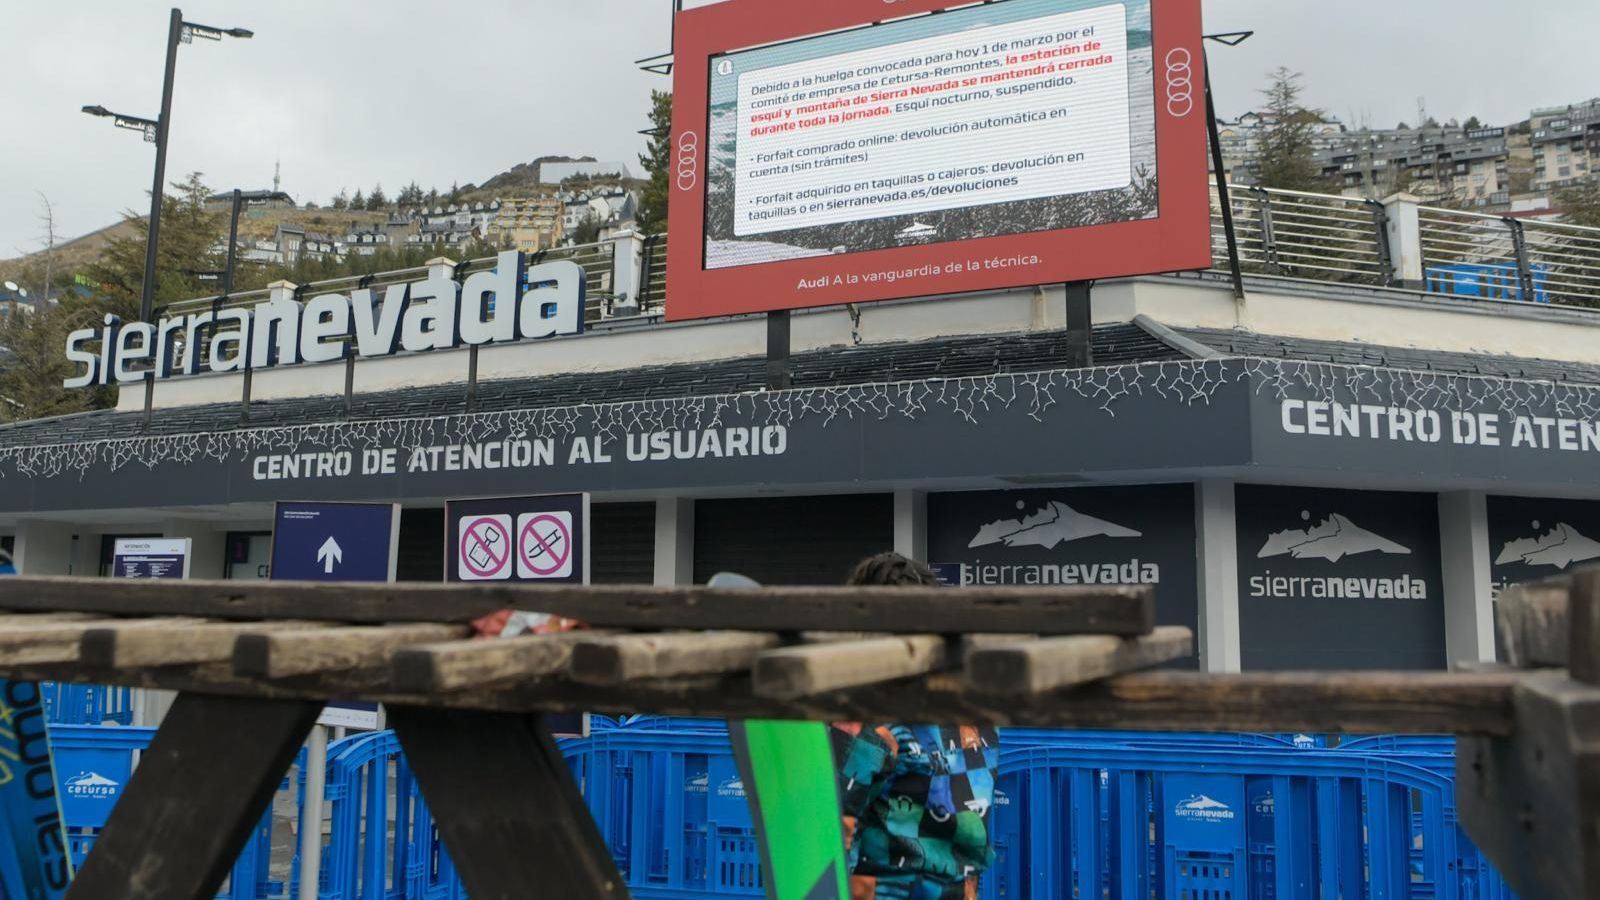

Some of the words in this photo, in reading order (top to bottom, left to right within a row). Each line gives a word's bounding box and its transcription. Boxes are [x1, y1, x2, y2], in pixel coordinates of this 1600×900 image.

[751, 81, 790, 96] Debido
[793, 80, 800, 89] a
[802, 76, 812, 86] la
[815, 69, 854, 85] huelga
[857, 57, 922, 76] convocada
[925, 53, 953, 68] para
[956, 46, 980, 60] hoy
[982, 44, 988, 55] 1
[992, 41, 1008, 53] de
[1011, 35, 1053, 50] marzo
[1056, 30, 1079, 45] por
[1082, 25, 1094, 37] el
[751, 93, 789, 109] comité
[792, 89, 806, 102] de
[808, 83, 861, 100] empresa
[863, 78, 879, 90] de
[881, 60, 1003, 86] Cetursa-Remontes,
[1006, 54, 1018, 65] la
[1021, 43, 1081, 62] estación
[1083, 40, 1101, 52] de
[784, 108, 792, 119] y
[796, 97, 850, 115] montaña
[853, 95, 869, 106] de
[871, 89, 908, 102] Sierra
[911, 80, 959, 95] Nevada
[962, 77, 977, 87] se
[980, 64, 1055, 84] mantendrá
[1058, 53, 1113, 72] cerrada
[750, 121, 796, 137] durante
[799, 116, 826, 128] toda
[829, 113, 840, 123] la
[841, 105, 892, 123] jornada.
[932, 88, 993, 107] nocturno,
[996, 76, 1077, 97] suspendido.
[756, 149, 794, 164] Forfait
[796, 140, 856, 158] comprado
[858, 134, 898, 147] online:
[901, 122, 968, 141] devolución
[971, 109, 1047, 130] automática
[1050, 107, 1067, 119] en
[749, 163, 789, 179] cuenta
[791, 160, 812, 174] (sin
[814, 152, 869, 169] trámites)
[756, 192, 793, 206] Forfait
[796, 183, 851, 200] adquirido
[854, 182, 869, 191] en
[872, 174, 924, 189] taquillas
[927, 172, 935, 181] o
[938, 165, 989, 181] cajeros:
[992, 154, 1064, 172] devolución
[1067, 151, 1084, 162] en
[749, 206, 797, 221] taquillas
[799, 204, 807, 214] o
[809, 202, 824, 212] en
[827, 176, 1018, 210] sierranevada.es/devoluciones
[797, 275, 829, 290] Audi
[833, 275, 843, 286] A
[846, 272, 859, 284] la
[862, 264, 941, 284] vanguardia
[945, 261, 963, 273] de
[967, 259, 980, 271] la
[983, 253, 1043, 270] técnica.
[63, 250, 584, 388] sierranevada
[252, 449, 353, 481] CENTRO
[362, 447, 397, 476] DE
[408, 432, 555, 473] ATENCIÓN
[568, 436, 613, 465] AL
[626, 424, 788, 462] USUARIO
[1281, 399, 1441, 443] CENTRO
[1452, 410, 1500, 446] DE
[1511, 416, 1600, 452] ATEN
[965, 558, 1160, 585] sierranevada
[1250, 570, 1427, 600] sierranevada
[68, 785, 116, 795] cetursa
[1174, 807, 1234, 819] sierranevada
